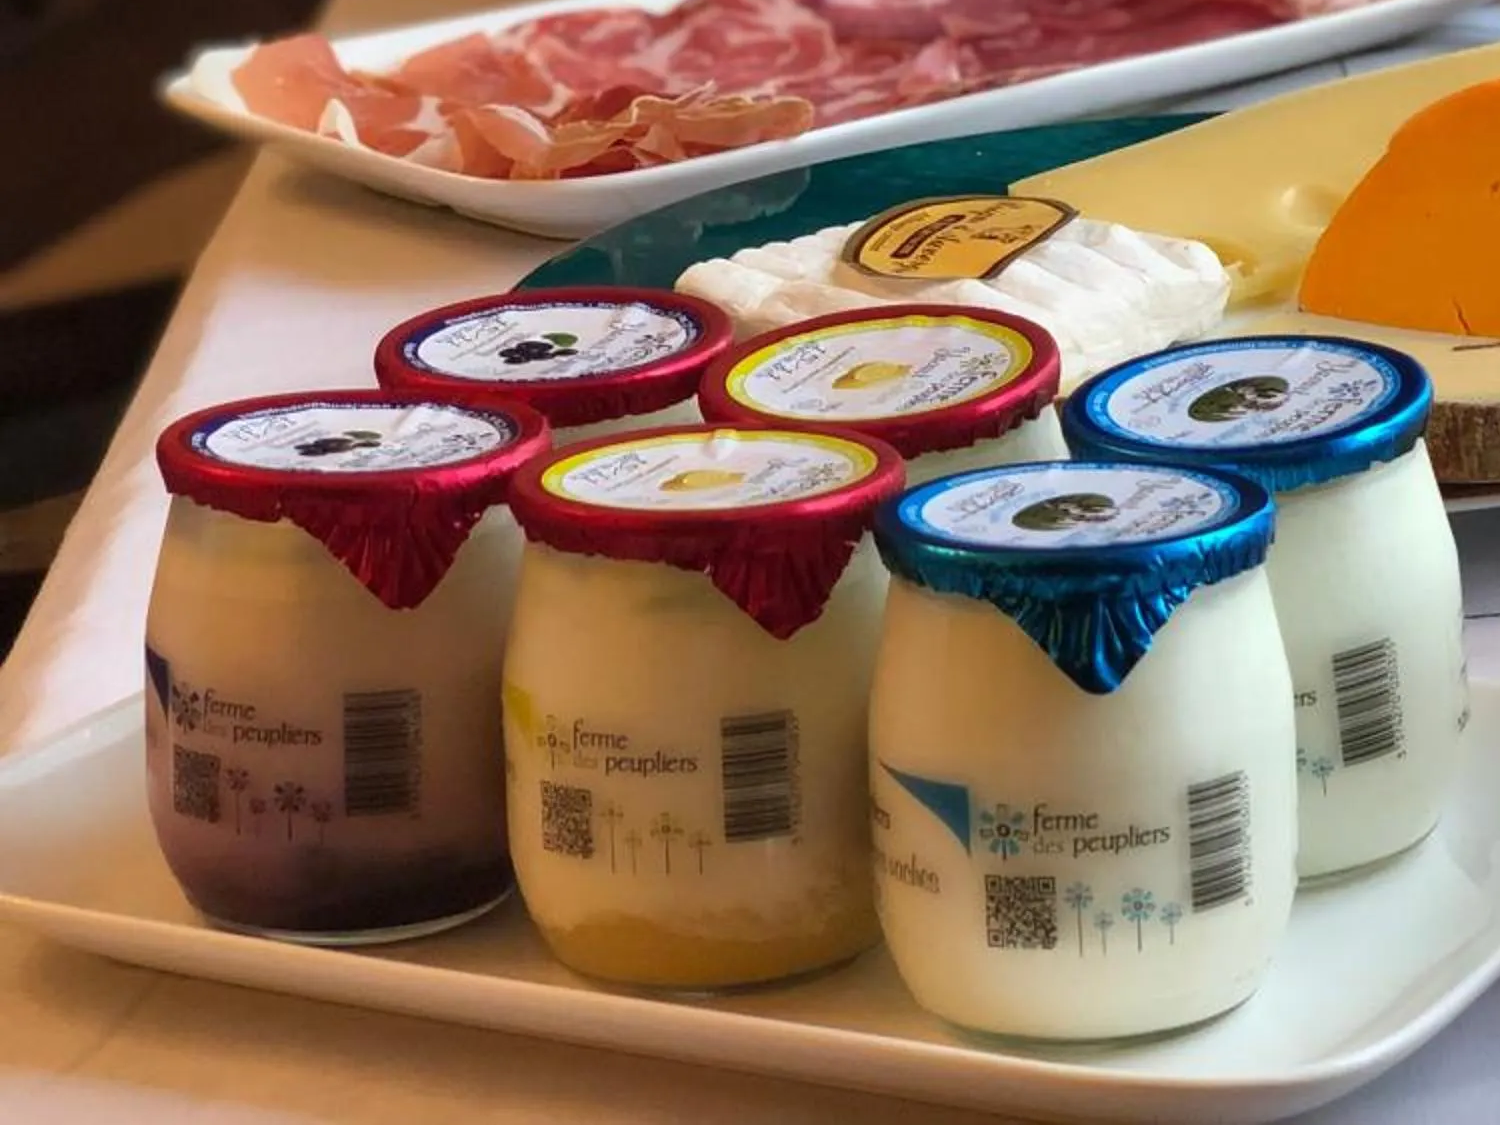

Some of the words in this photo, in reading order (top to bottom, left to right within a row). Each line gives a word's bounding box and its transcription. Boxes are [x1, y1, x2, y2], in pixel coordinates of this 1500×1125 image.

[203, 688, 257, 720] ferme
[233, 722, 323, 748] peupliers
[573, 717, 630, 750] ferme
[605, 751, 699, 778] peupliers
[1032, 802, 1099, 834] ferme
[1032, 839, 1065, 855] des
[1072, 823, 1171, 859] peupliers
